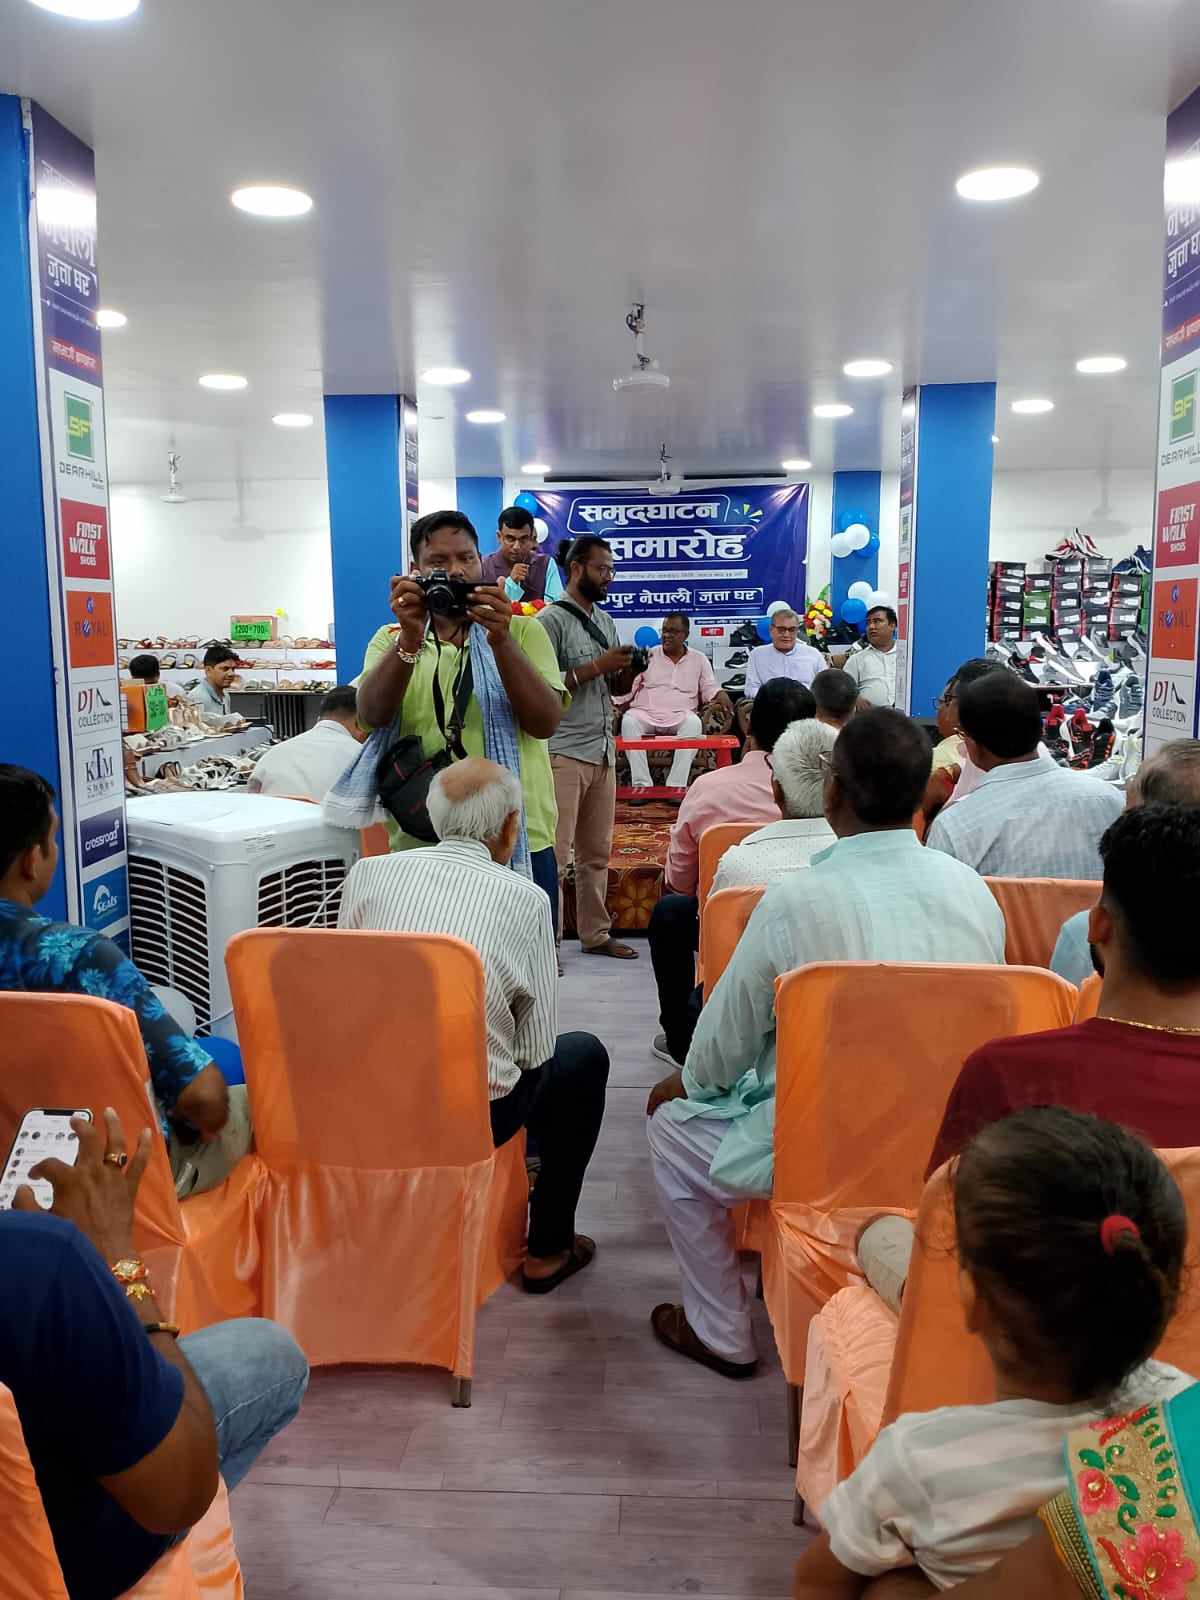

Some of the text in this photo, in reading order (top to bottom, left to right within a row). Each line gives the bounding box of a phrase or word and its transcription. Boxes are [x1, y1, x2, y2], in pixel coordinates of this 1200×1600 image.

[59, 461, 104, 483] DEARHILL
[1170, 504, 1196, 525] FIRST
[76, 521, 102, 540] FIRST
[1162, 524, 1188, 543] WALK
[69, 537, 97, 555] WALK
[602, 529, 747, 561] समारोह
[639, 587, 693, 604] नेपाली
[734, 590, 758, 601] घर
[77, 688, 94, 713] DJ
[1153, 681, 1169, 706] DJ
[78, 711, 114, 729] COLLECTION
[1152, 706, 1186, 723] COLLECTION
[85, 748, 115, 784] KTM
